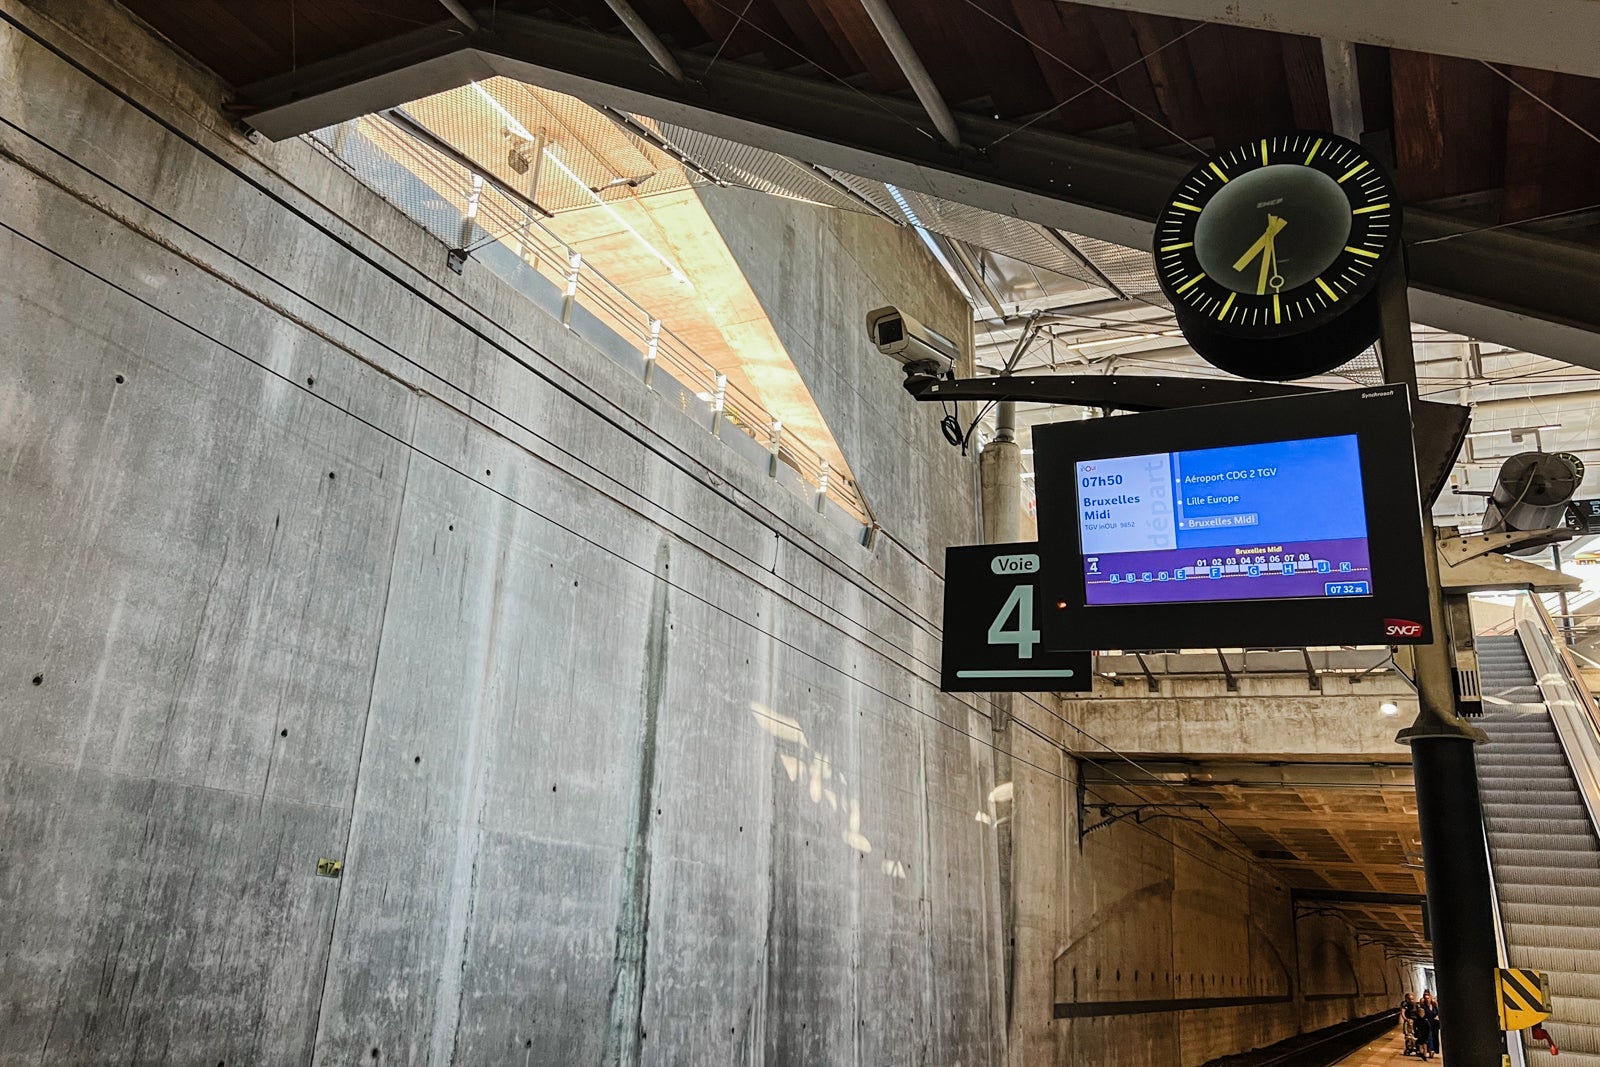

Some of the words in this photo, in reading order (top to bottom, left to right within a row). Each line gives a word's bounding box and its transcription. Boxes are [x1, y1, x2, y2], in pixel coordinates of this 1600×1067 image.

[1082, 474, 1123, 488] 07h50
[1185, 474, 1224, 484] Aéroport
[1226, 471, 1248, 480] CDG
[1250, 470, 1255, 478] 2
[1257, 468, 1278, 477] TGV
[1084, 495, 1141, 507] Bruxelles
[1145, 460, 1171, 548] départ
[1186, 496, 1205, 506] Lille
[1207, 494, 1240, 504] Europe
[1084, 510, 1111, 520] Midi
[1592, 505, 1600, 516] 5
[1189, 517, 1232, 528] Bruxelles
[1234, 515, 1255, 525] Midi
[1235, 547, 1266, 555] Bruxelles
[998, 558, 1032, 571] Voie
[1090, 562, 1098, 572] 4
[1212, 558, 1222, 566] 02
[1226, 557, 1236, 565] 03
[1241, 556, 1251, 564] 04
[1344, 585, 1354, 593] 32
[988, 585, 1040, 658] 4
[1386, 626, 1420, 635] SNCF
[324, 862, 335, 874] 17
